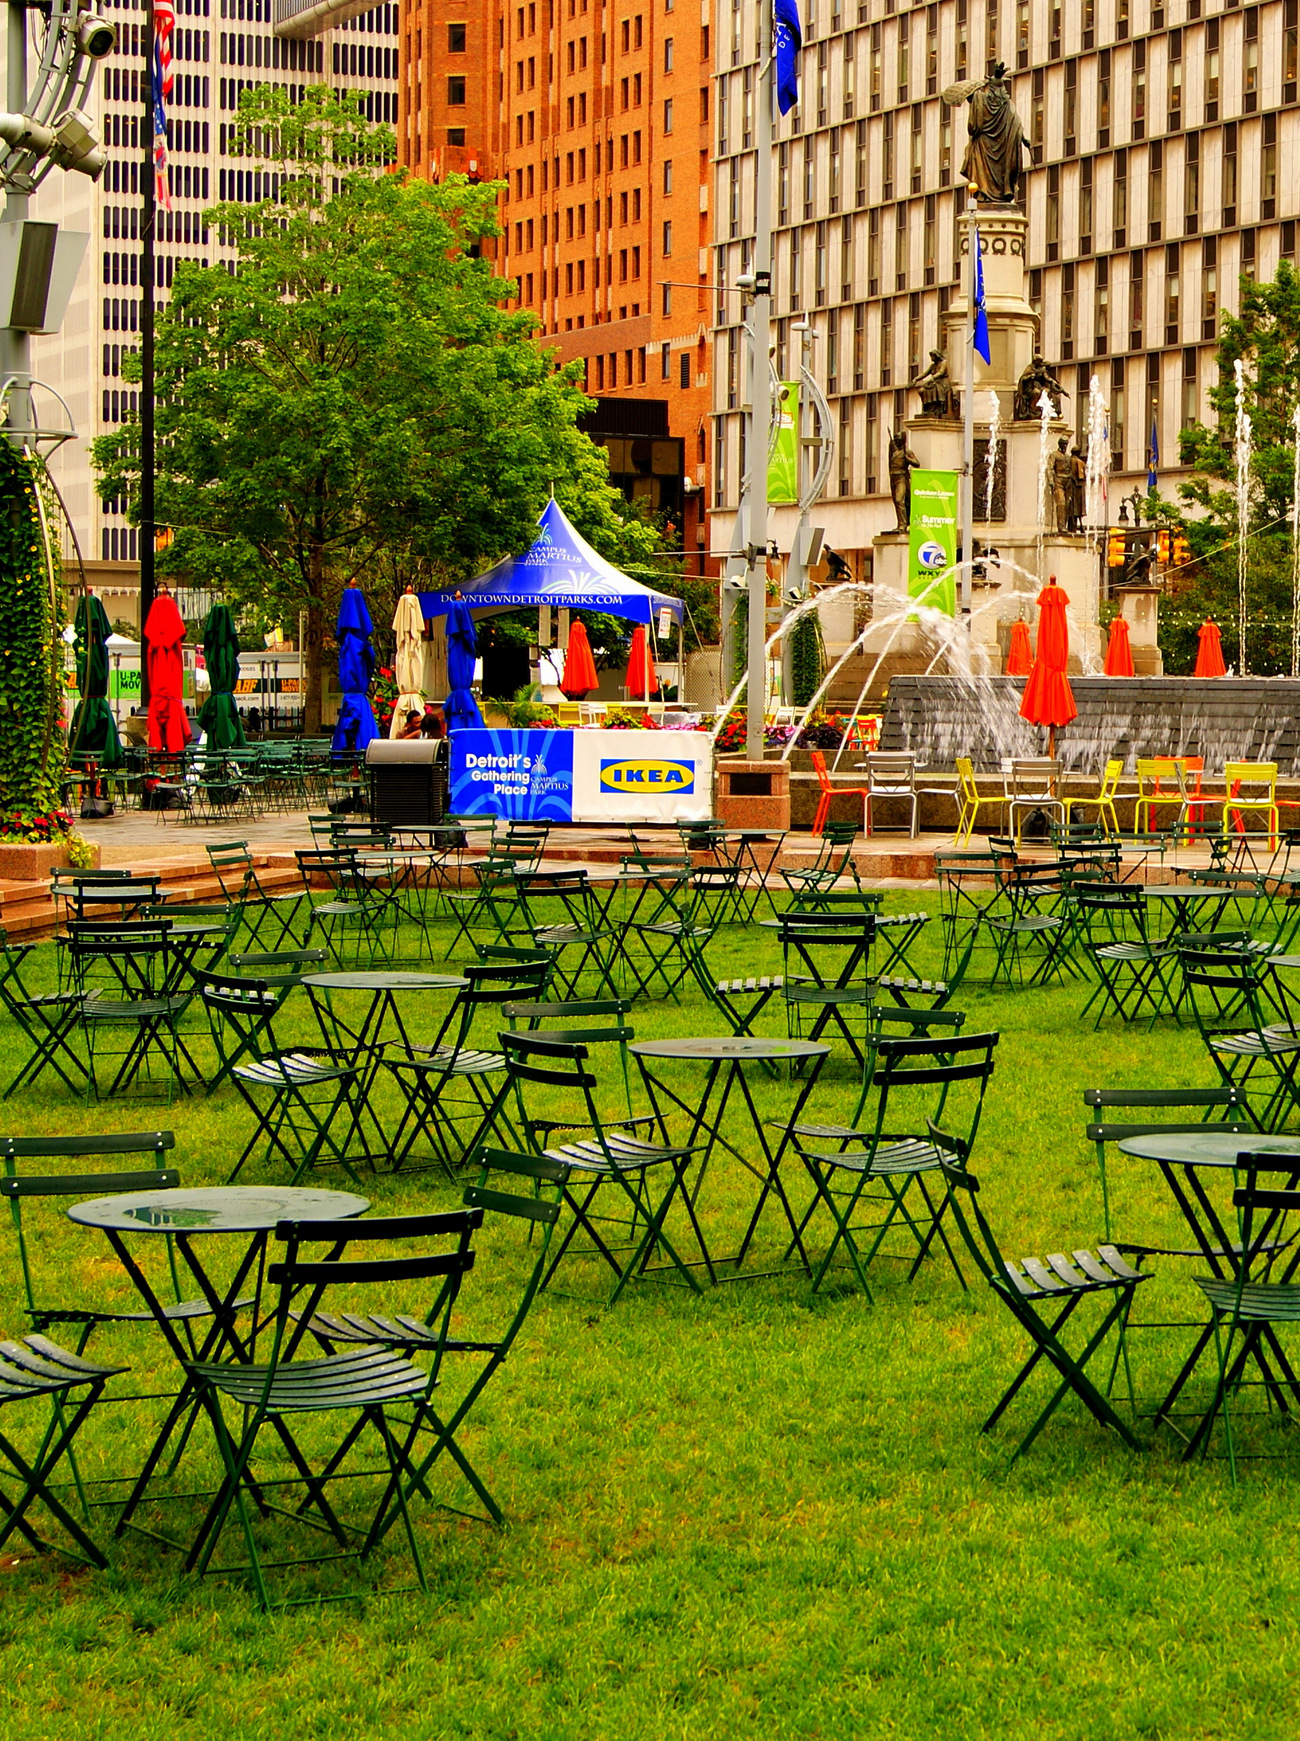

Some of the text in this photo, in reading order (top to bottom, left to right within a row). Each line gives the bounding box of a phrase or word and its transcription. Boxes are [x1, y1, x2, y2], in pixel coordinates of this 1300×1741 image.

[922, 515, 956, 525] Summer
[526, 552, 582, 563] MARTIUS
[935, 557, 948, 565] abc
[233, 680, 258, 693] ABF
[465, 753, 531, 769] Detroit's
[471, 770, 530, 785] Gathering
[613, 769, 684, 783] IKEA
[493, 783, 528, 795] Place
[530, 782, 569, 790] MARTIUS
